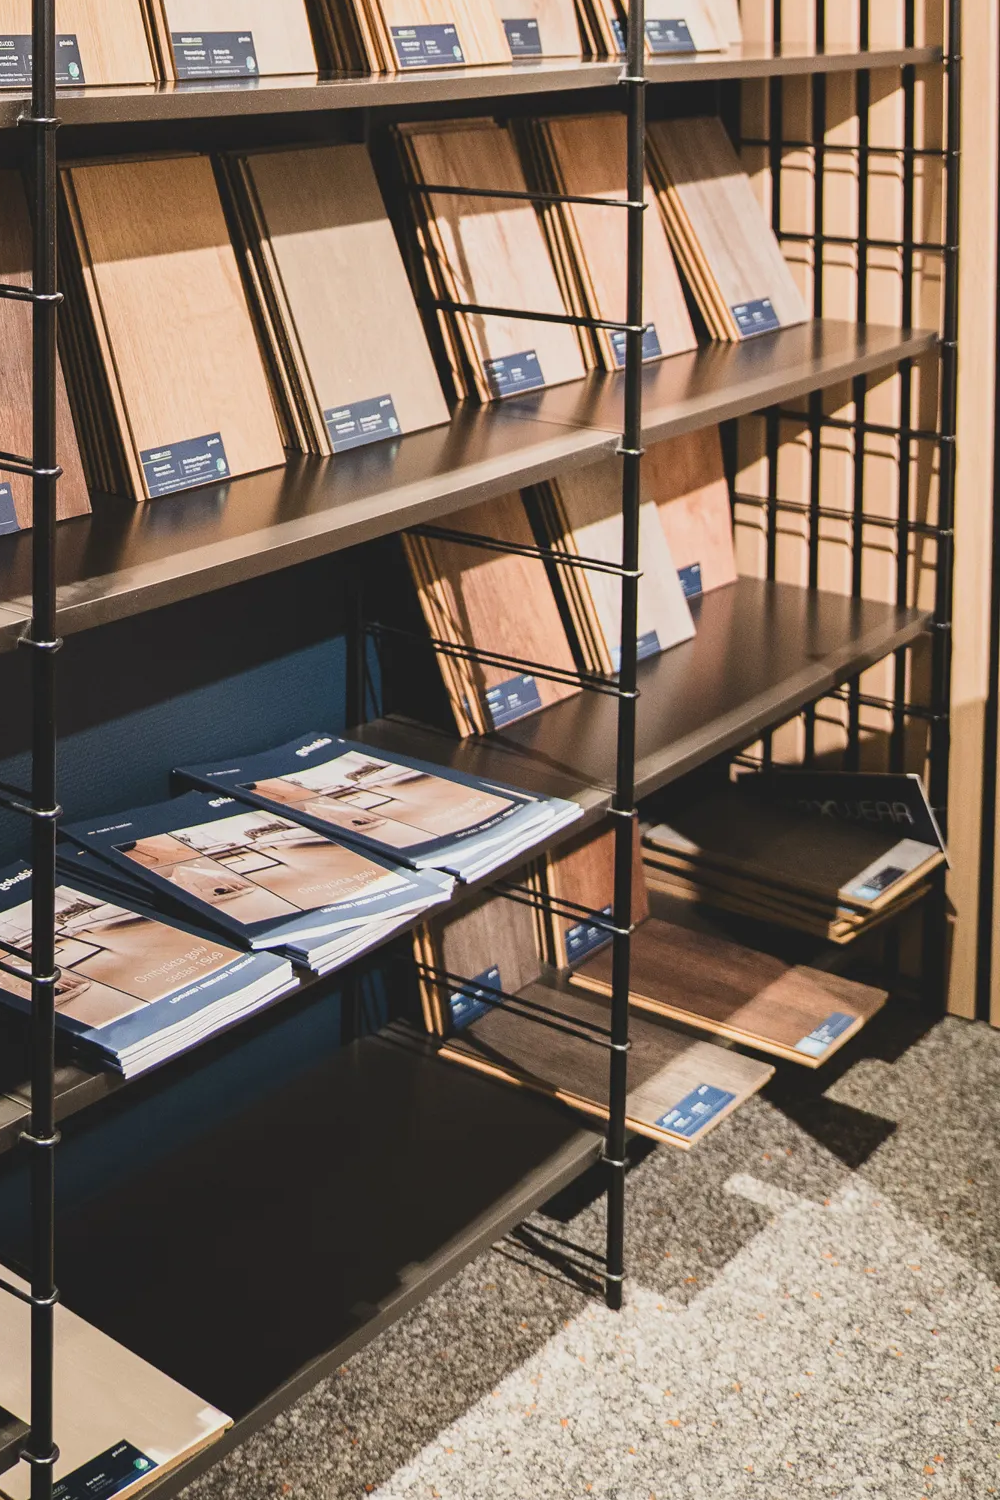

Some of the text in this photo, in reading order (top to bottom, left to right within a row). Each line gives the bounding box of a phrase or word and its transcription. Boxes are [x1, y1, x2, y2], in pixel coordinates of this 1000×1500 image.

[134, 945, 208, 984] Omtyckta golv
[166, 966, 199, 983] sedan
[195, 951, 224, 967] 1949
